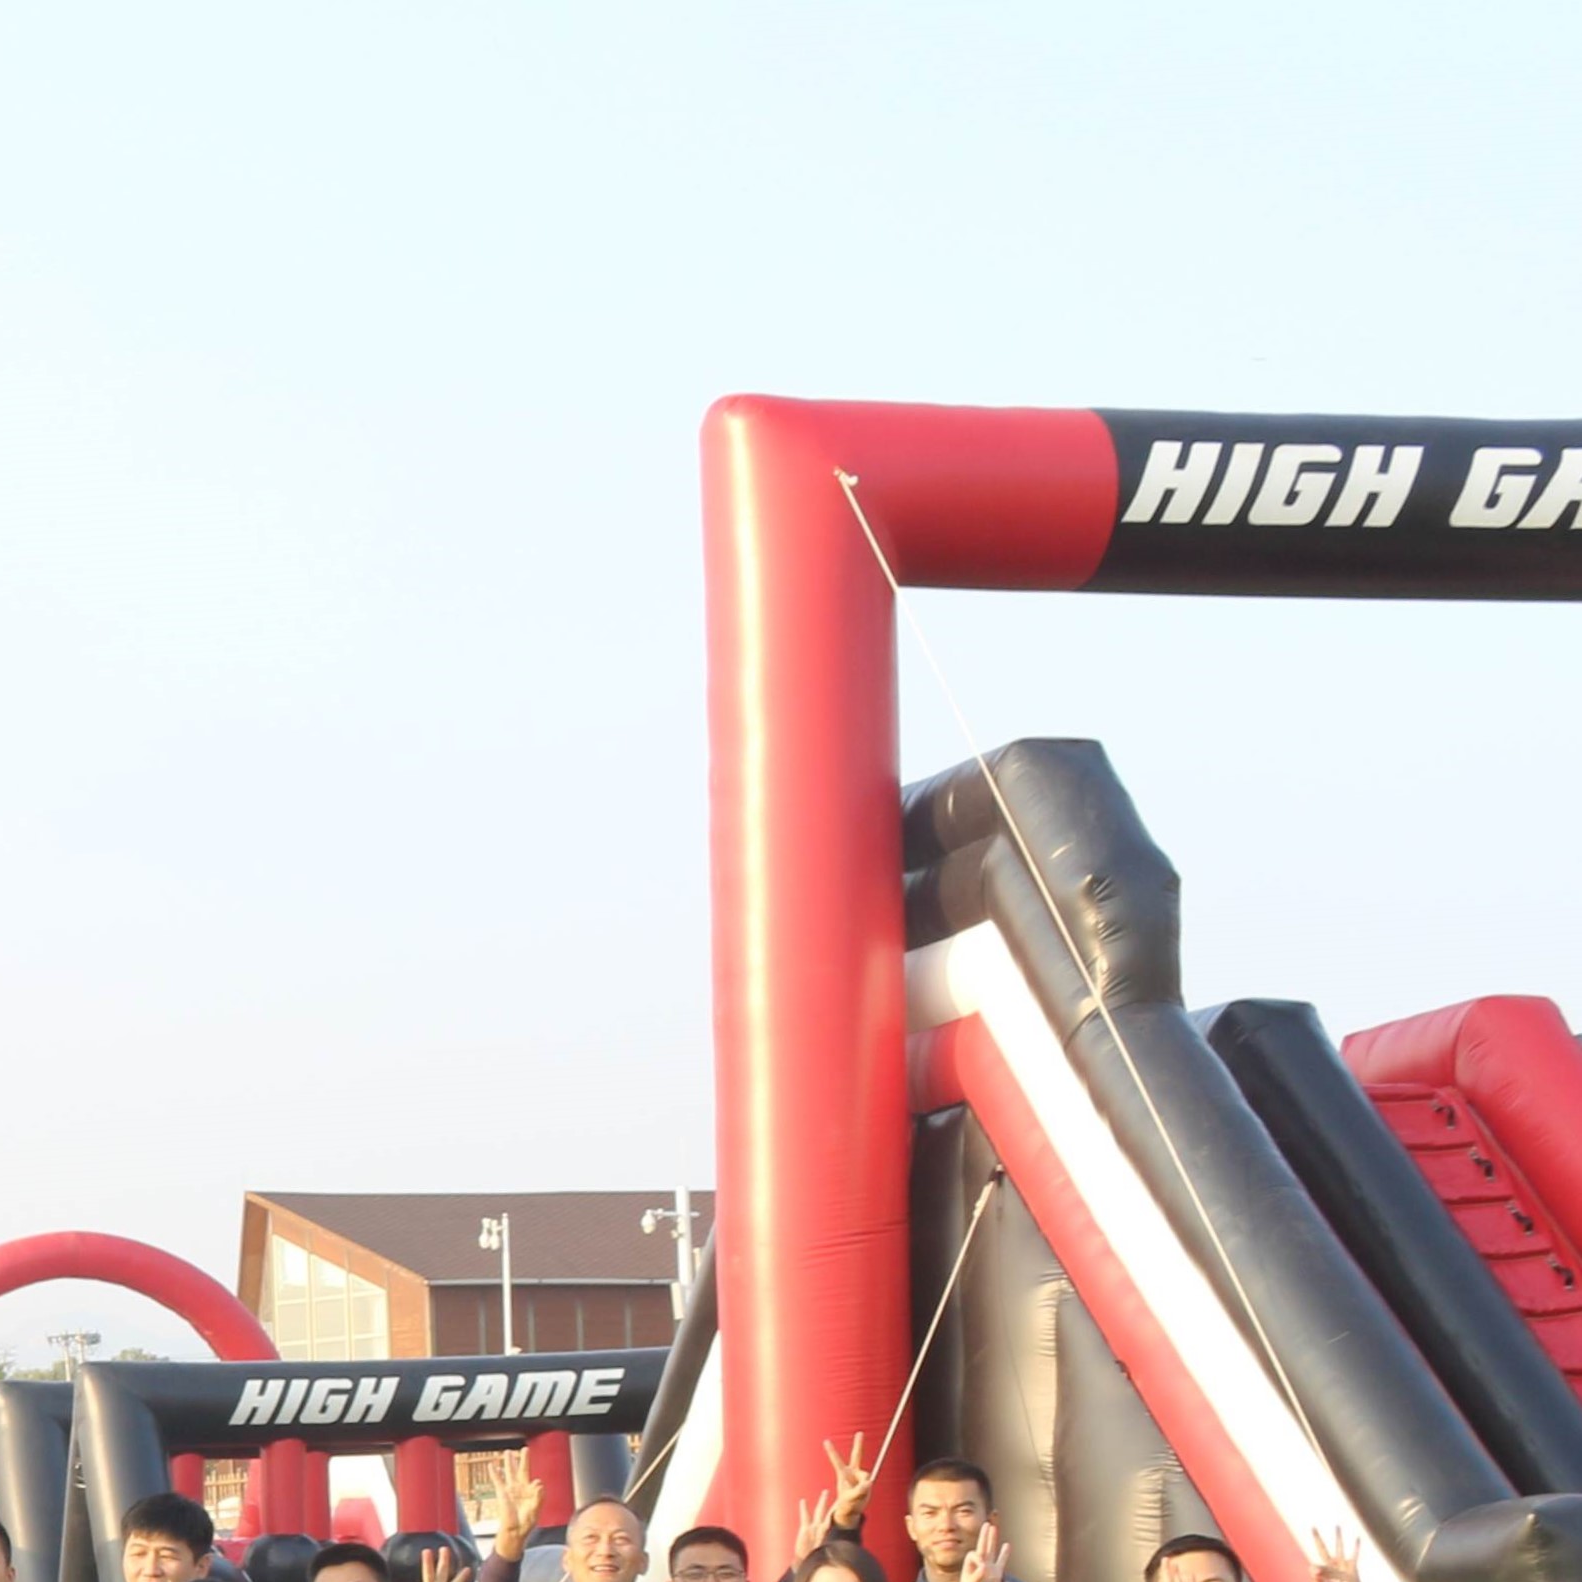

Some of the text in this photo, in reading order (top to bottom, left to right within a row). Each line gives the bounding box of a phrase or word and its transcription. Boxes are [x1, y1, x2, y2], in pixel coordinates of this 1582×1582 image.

[1121, 440, 1424, 528] HIGH
[228, 1368, 626, 1426] HIGH GAME
